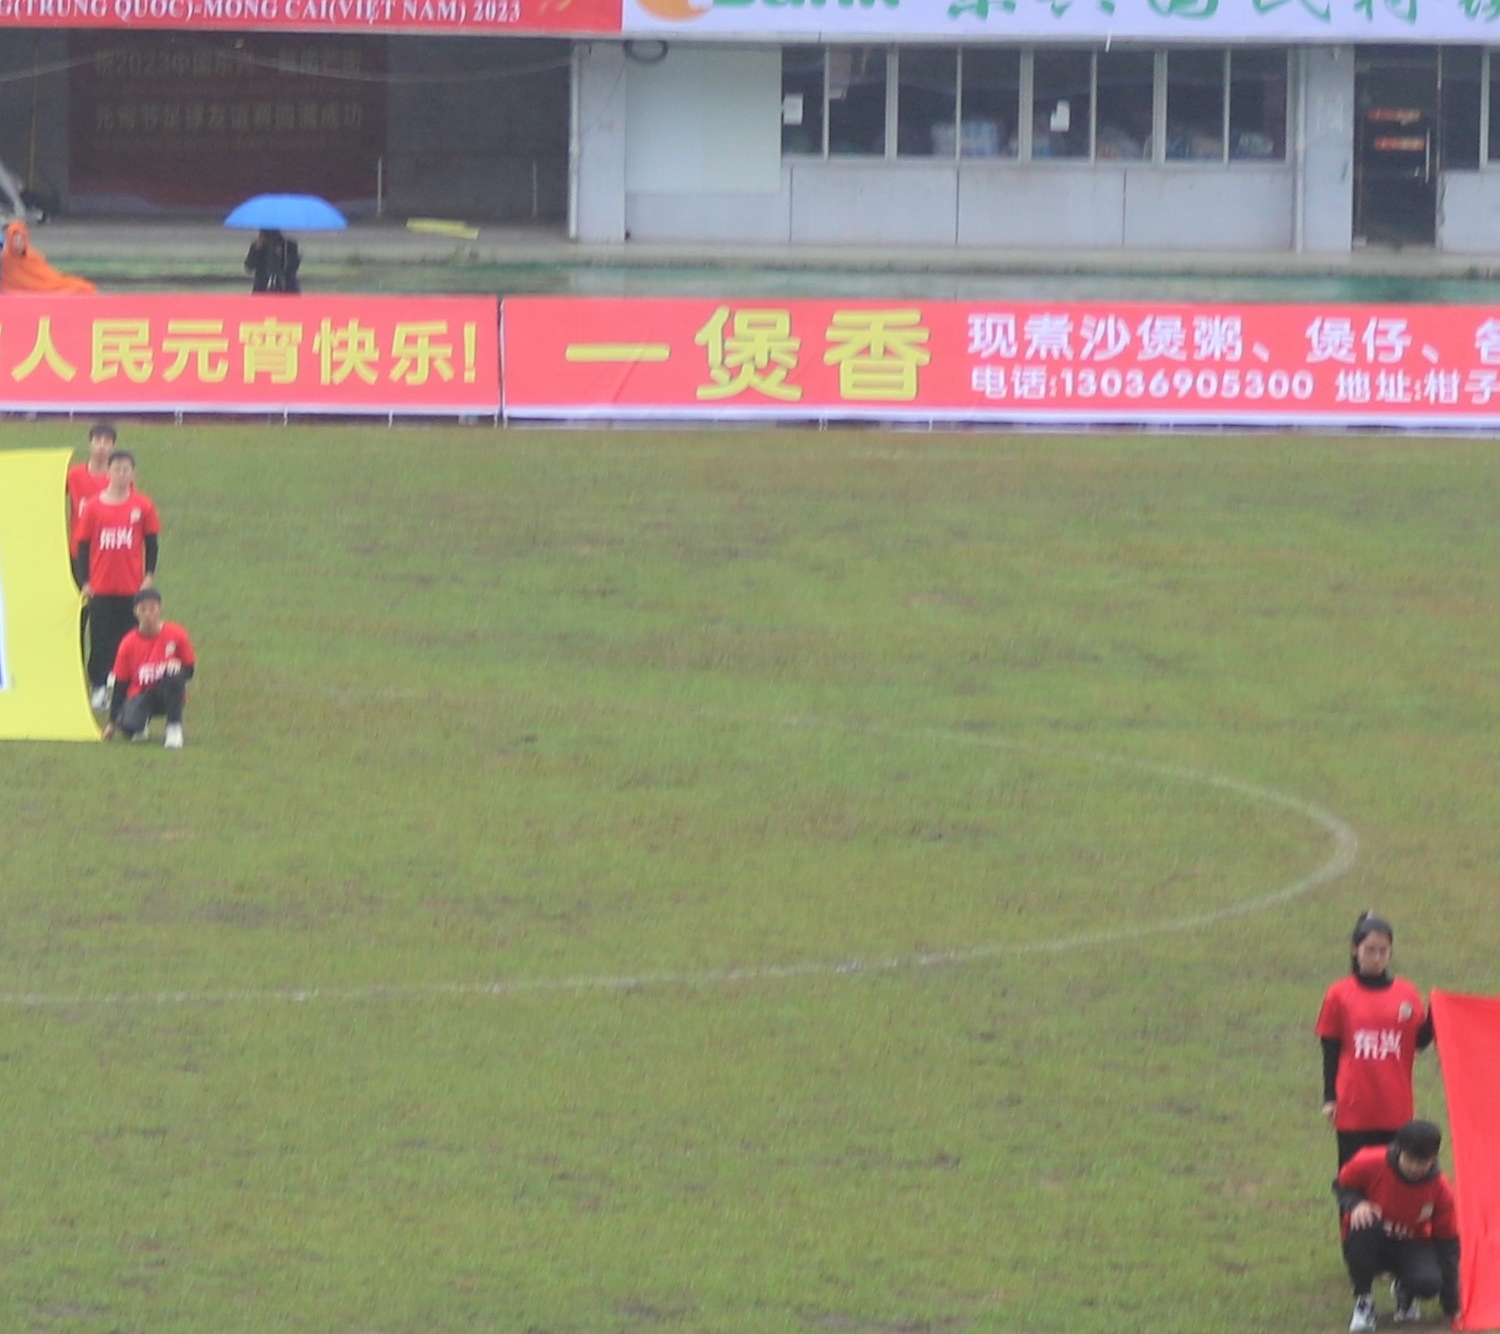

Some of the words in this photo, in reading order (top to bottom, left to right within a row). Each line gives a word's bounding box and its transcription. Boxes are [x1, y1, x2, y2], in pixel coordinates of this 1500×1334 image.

[566, 307, 932, 402] 一煲香
[971, 365, 1314, 400] 电话:13036905300
[1353, 1028, 1403, 1060] 东兴
